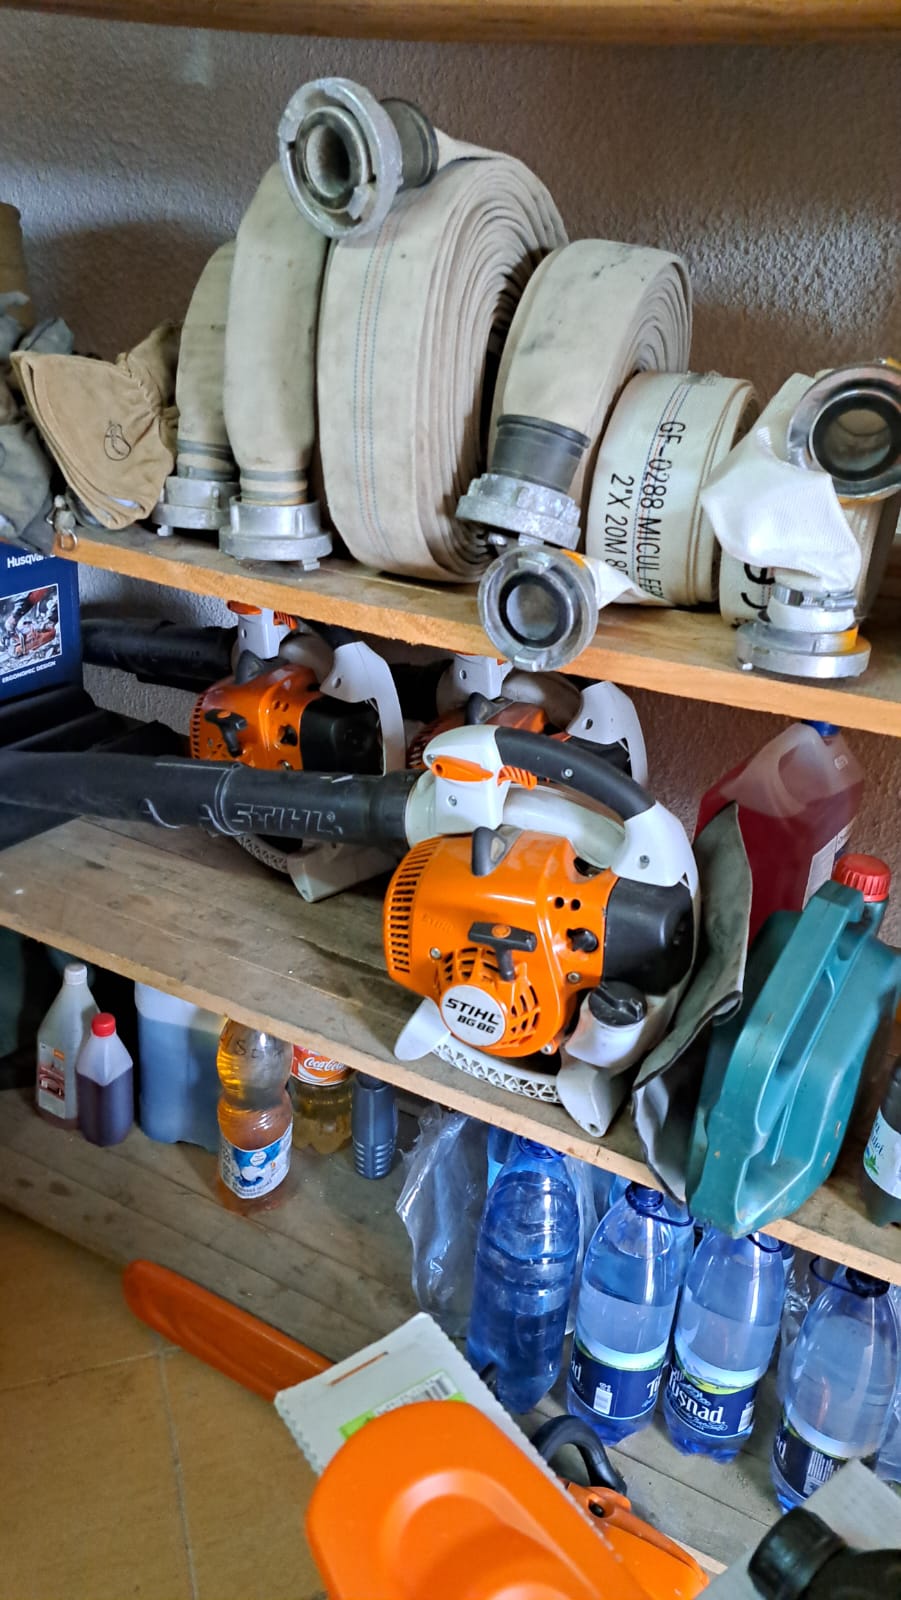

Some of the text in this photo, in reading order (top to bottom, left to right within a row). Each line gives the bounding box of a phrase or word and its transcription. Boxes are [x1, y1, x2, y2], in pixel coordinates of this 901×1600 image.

[641, 421, 686, 509] GF-0288
[604, 514, 629, 555] 20M
[636, 517, 662, 572] MICUL
[7, 552, 56, 569] Husqva
[232, 802, 335, 835] STIHL
[445, 997, 500, 1026] STIHL
